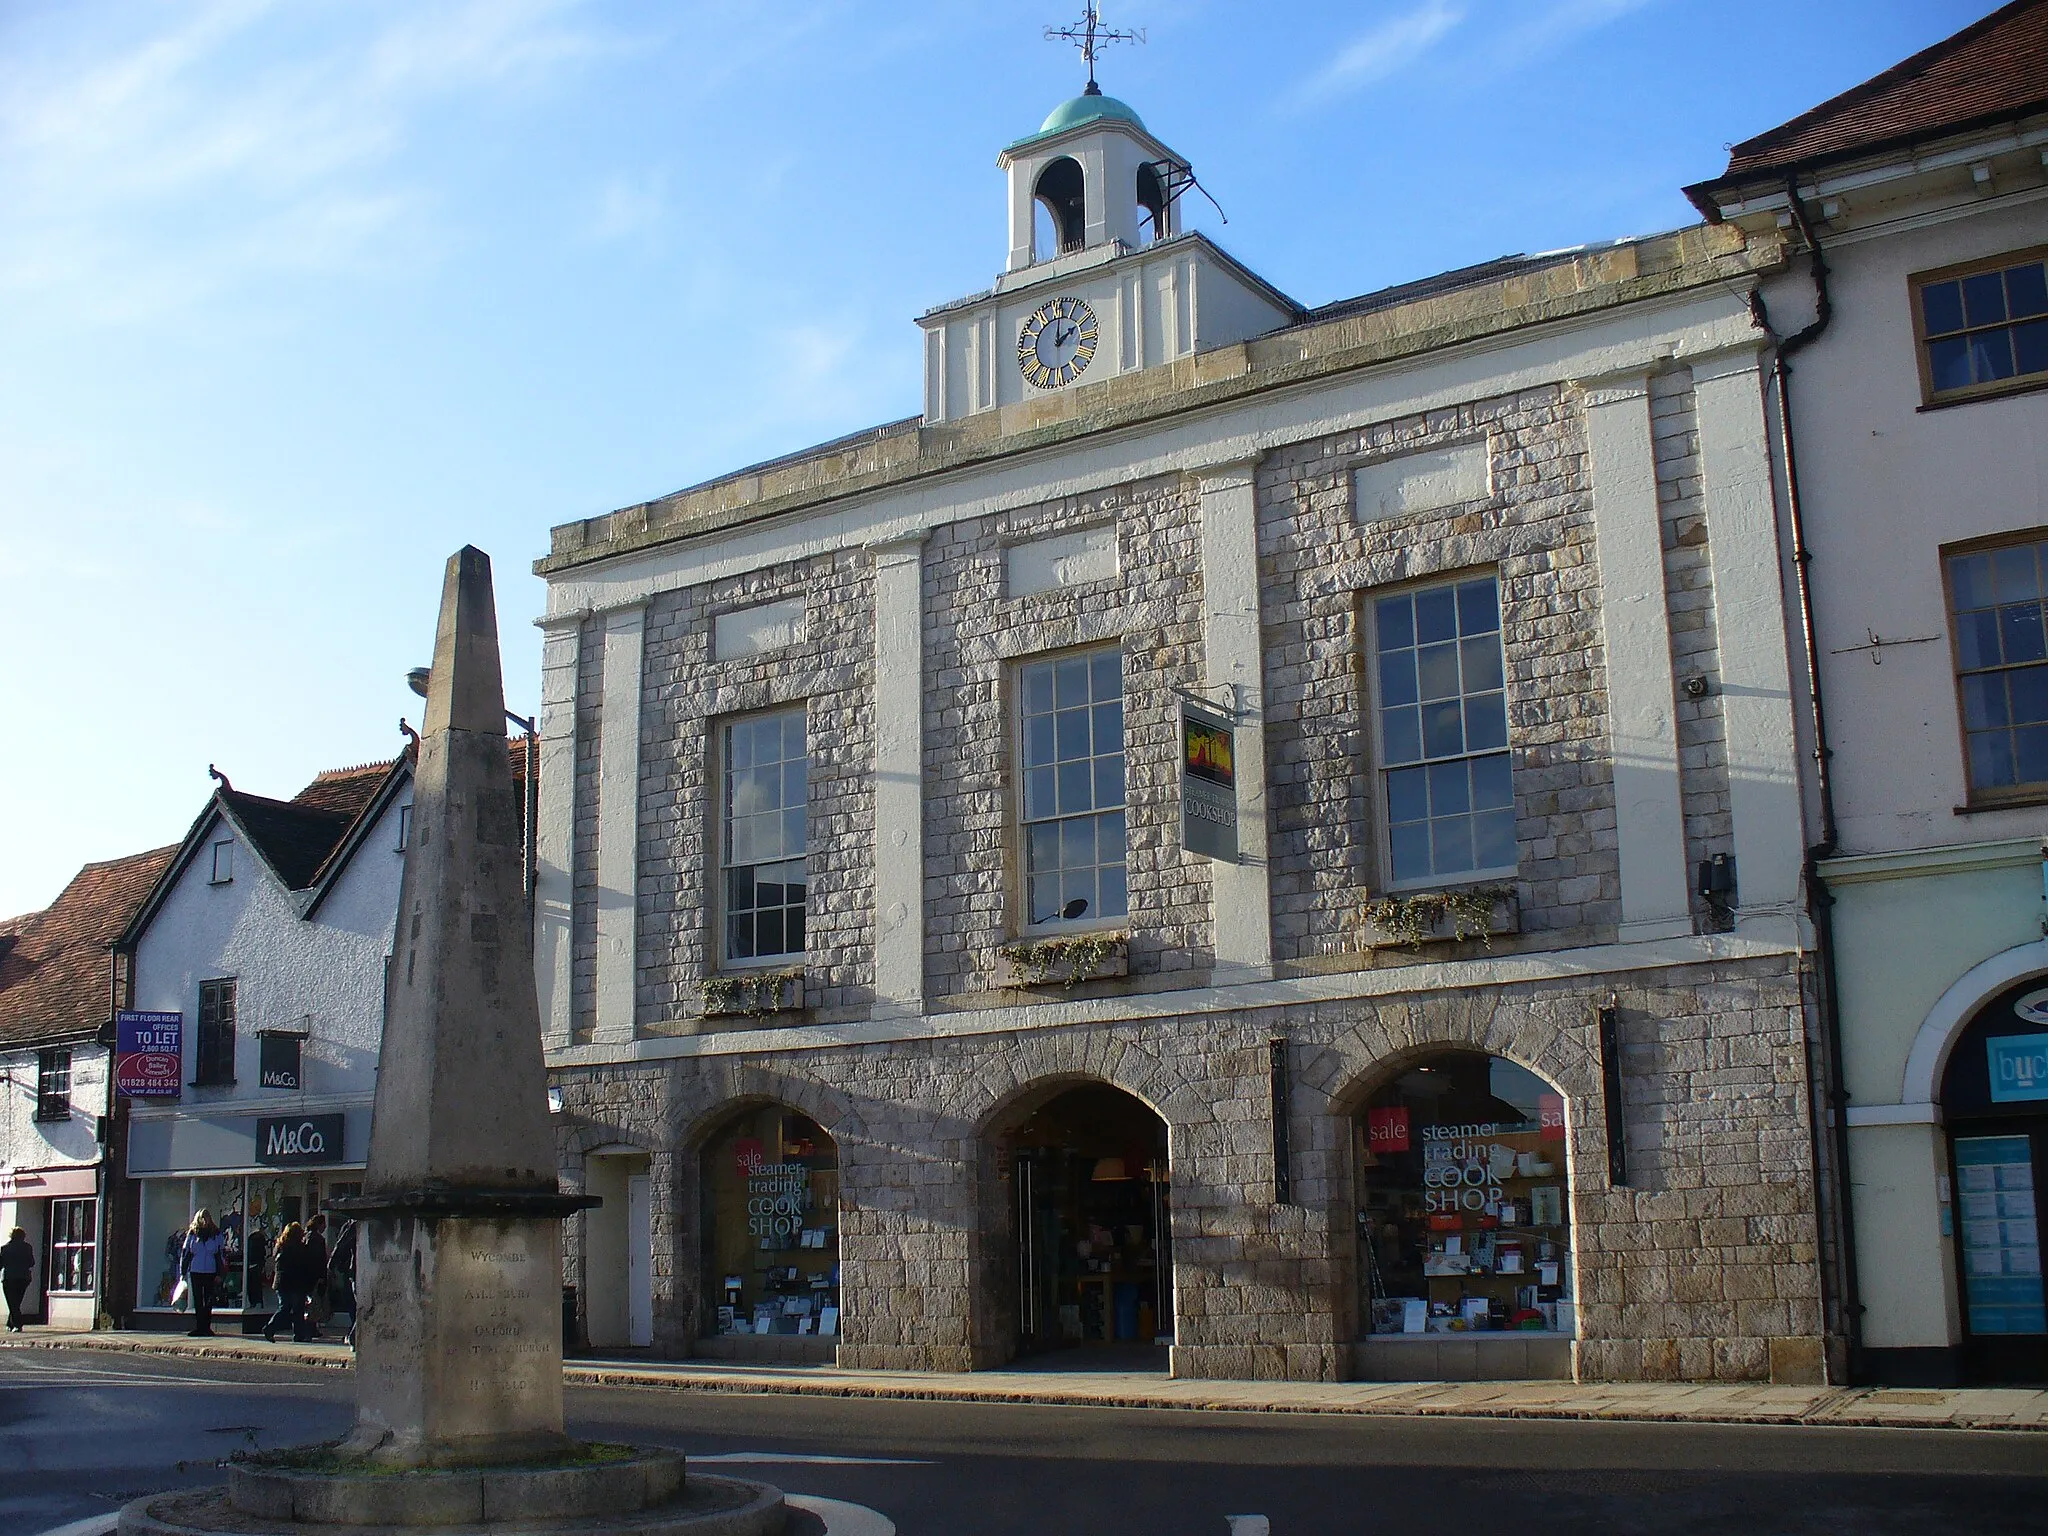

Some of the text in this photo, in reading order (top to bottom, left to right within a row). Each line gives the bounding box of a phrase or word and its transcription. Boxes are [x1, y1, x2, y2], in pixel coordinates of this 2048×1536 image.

[1185, 797, 1236, 828] COOKSHOP
[120, 1014, 139, 1022] FIRST
[135, 1031, 178, 1044] TO LET
[263, 1071, 296, 1087] M&Co.
[1369, 1118, 1407, 1140] sale
[1421, 1121, 1498, 1140] steamer
[266, 1122, 325, 1156] M&Co.
[737, 1148, 762, 1167] sale
[1423, 1140, 1500, 1160] trading
[748, 1163, 801, 1177] steamer
[1423, 1165, 1503, 1188] COOK
[748, 1176, 802, 1195] trading
[748, 1197, 802, 1216] COOK
[1424, 1188, 1503, 1213] SHOP
[748, 1217, 803, 1236] SHOP
[470, 1250, 526, 1263] WYCOMBE
